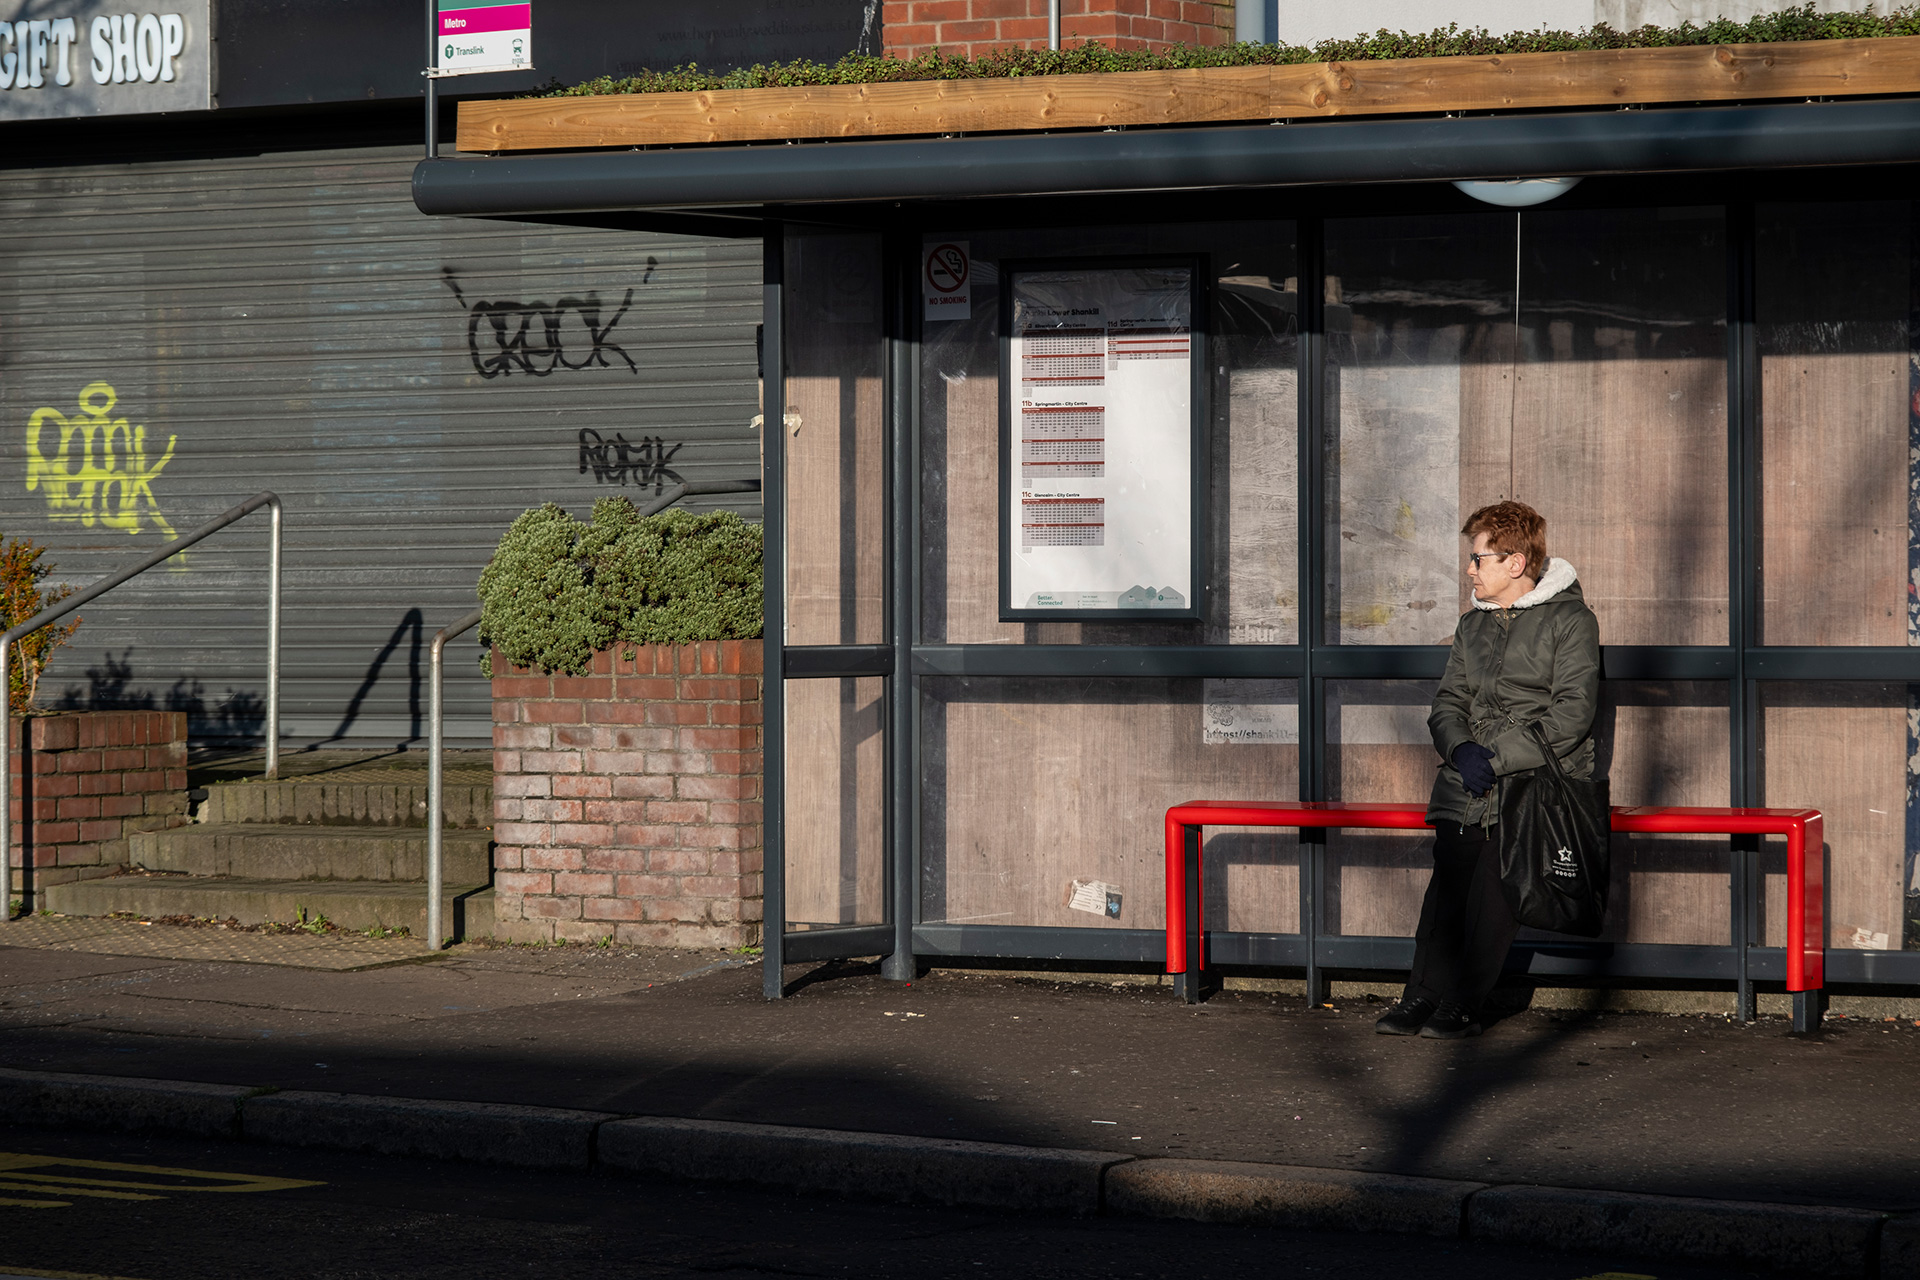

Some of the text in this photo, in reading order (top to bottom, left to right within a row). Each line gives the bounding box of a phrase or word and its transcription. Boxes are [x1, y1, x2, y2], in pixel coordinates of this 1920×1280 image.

[444, 18, 467, 29] Metro
[0, 13, 184, 90] GIFT SHOP
[456, 46, 485, 56] Translink
[929, 296, 967, 305] NO SMOKING
[1071, 308, 1100, 316] Shankill
